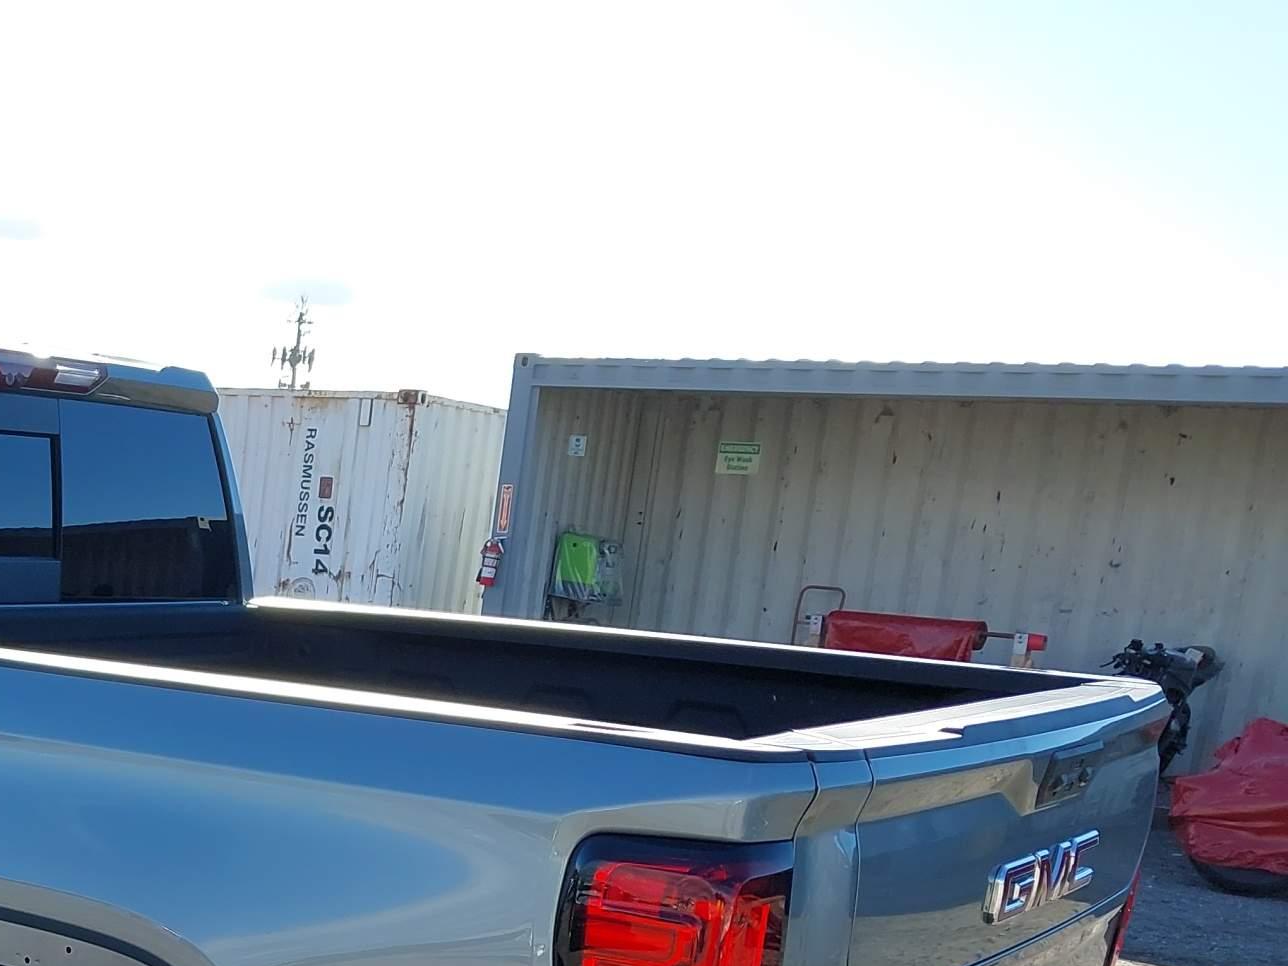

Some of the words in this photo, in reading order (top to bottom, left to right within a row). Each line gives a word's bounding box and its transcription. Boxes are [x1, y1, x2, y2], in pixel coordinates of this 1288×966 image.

[295, 427, 317, 537] RASMUSSEN
[312, 504, 335, 575] SC14
[982, 829, 1101, 926] GMC
